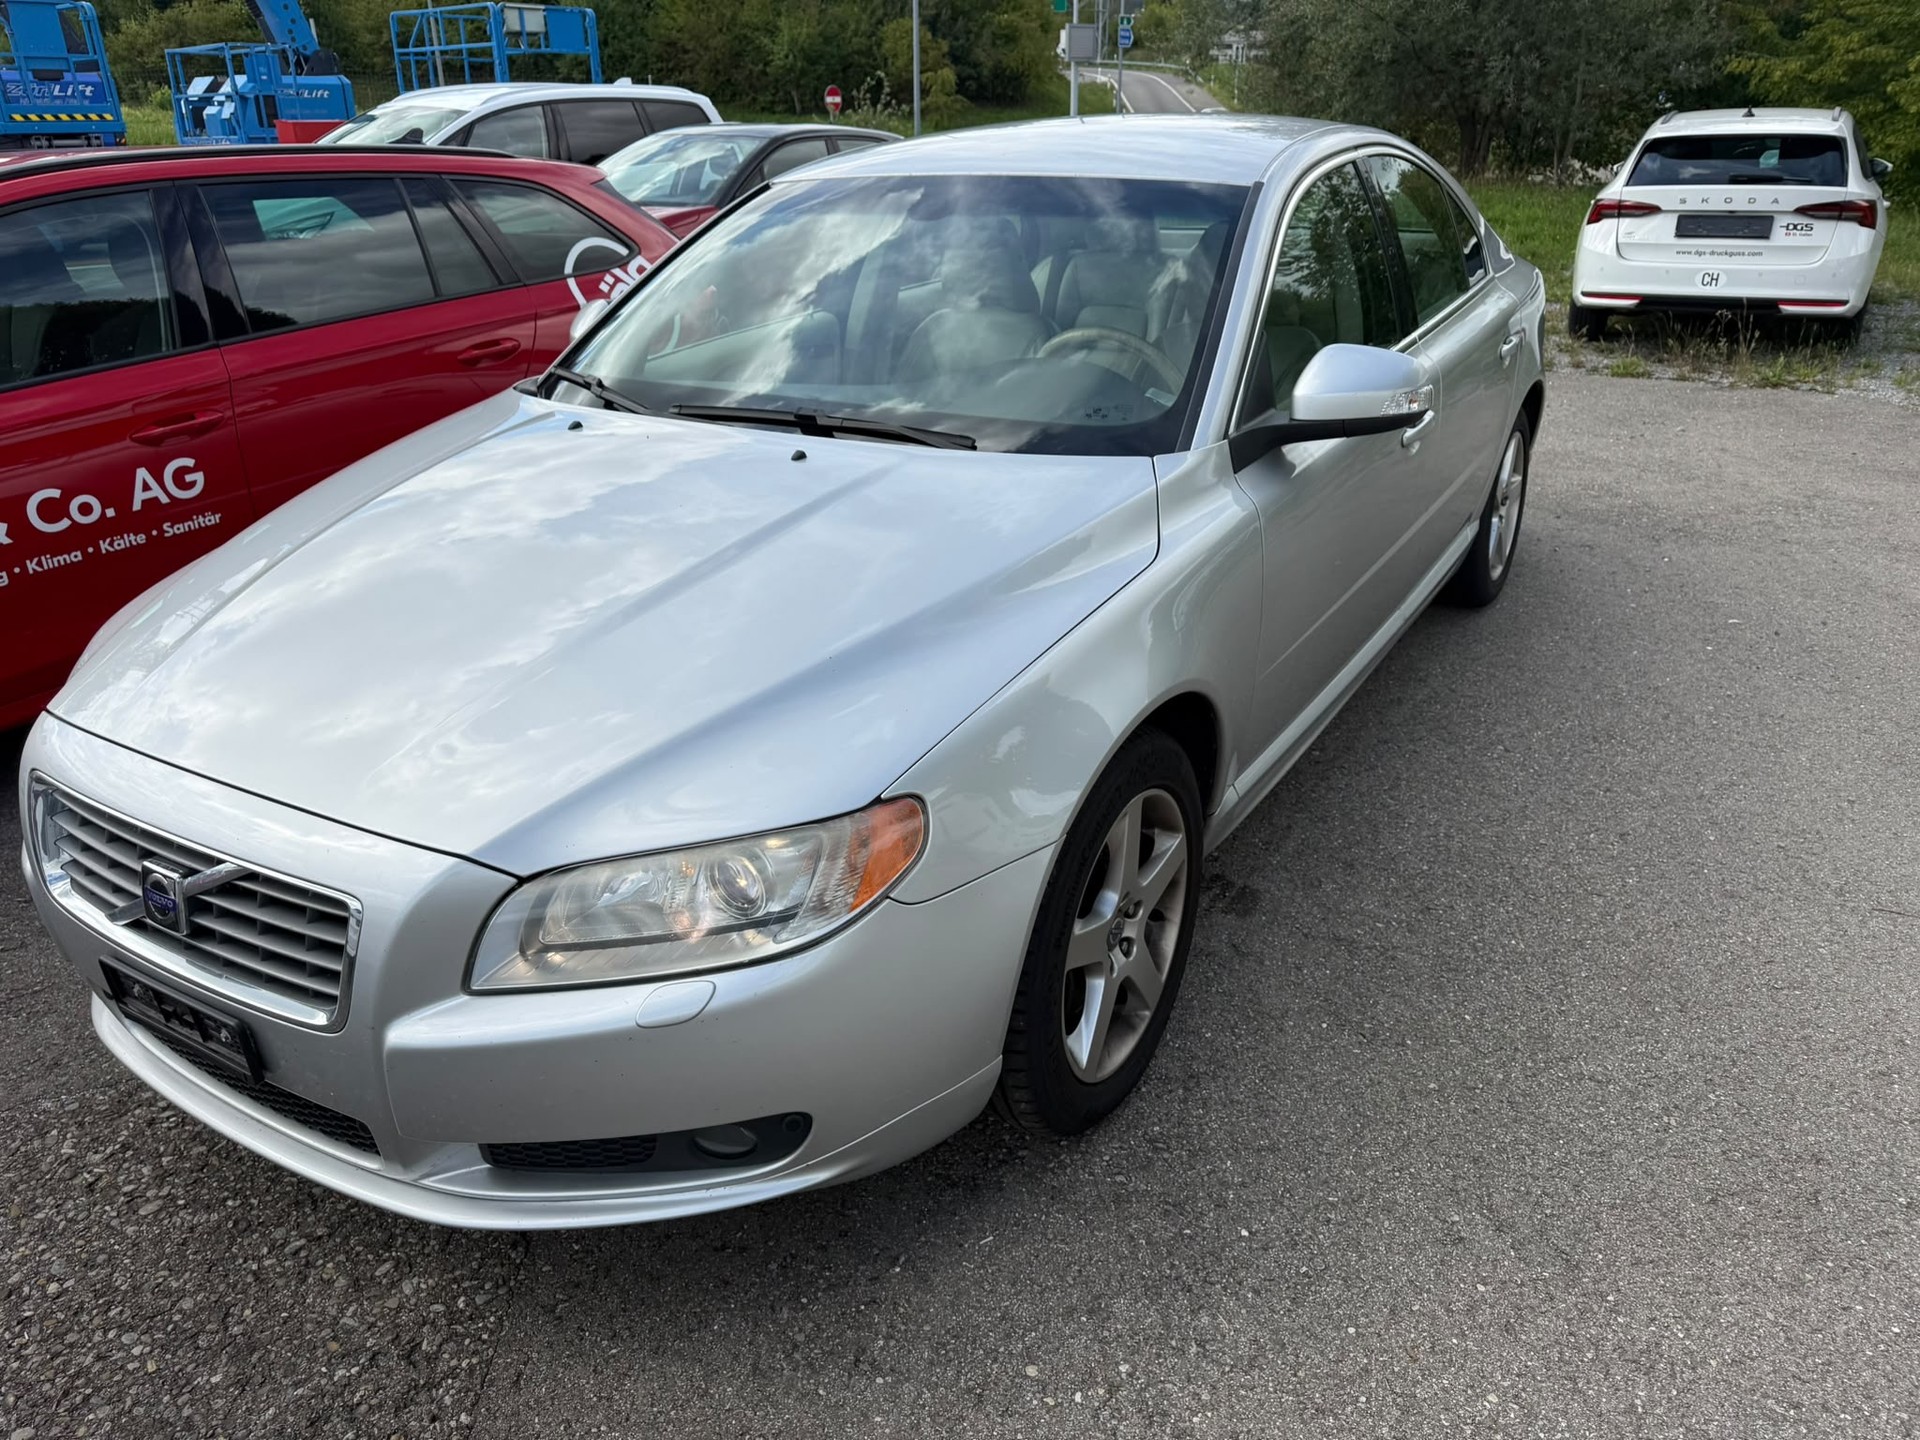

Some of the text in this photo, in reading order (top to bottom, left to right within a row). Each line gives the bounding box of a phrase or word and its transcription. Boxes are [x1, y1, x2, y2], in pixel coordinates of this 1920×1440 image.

[1676, 249, 1763, 258] www.dgs-druckguss.com
[1701, 272, 1720, 287] CH
[26, 457, 205, 533] Co. AG
[25, 548, 83, 575] Klima
[99, 532, 147, 554] Kälte
[162, 511, 222, 538] Sanitär
